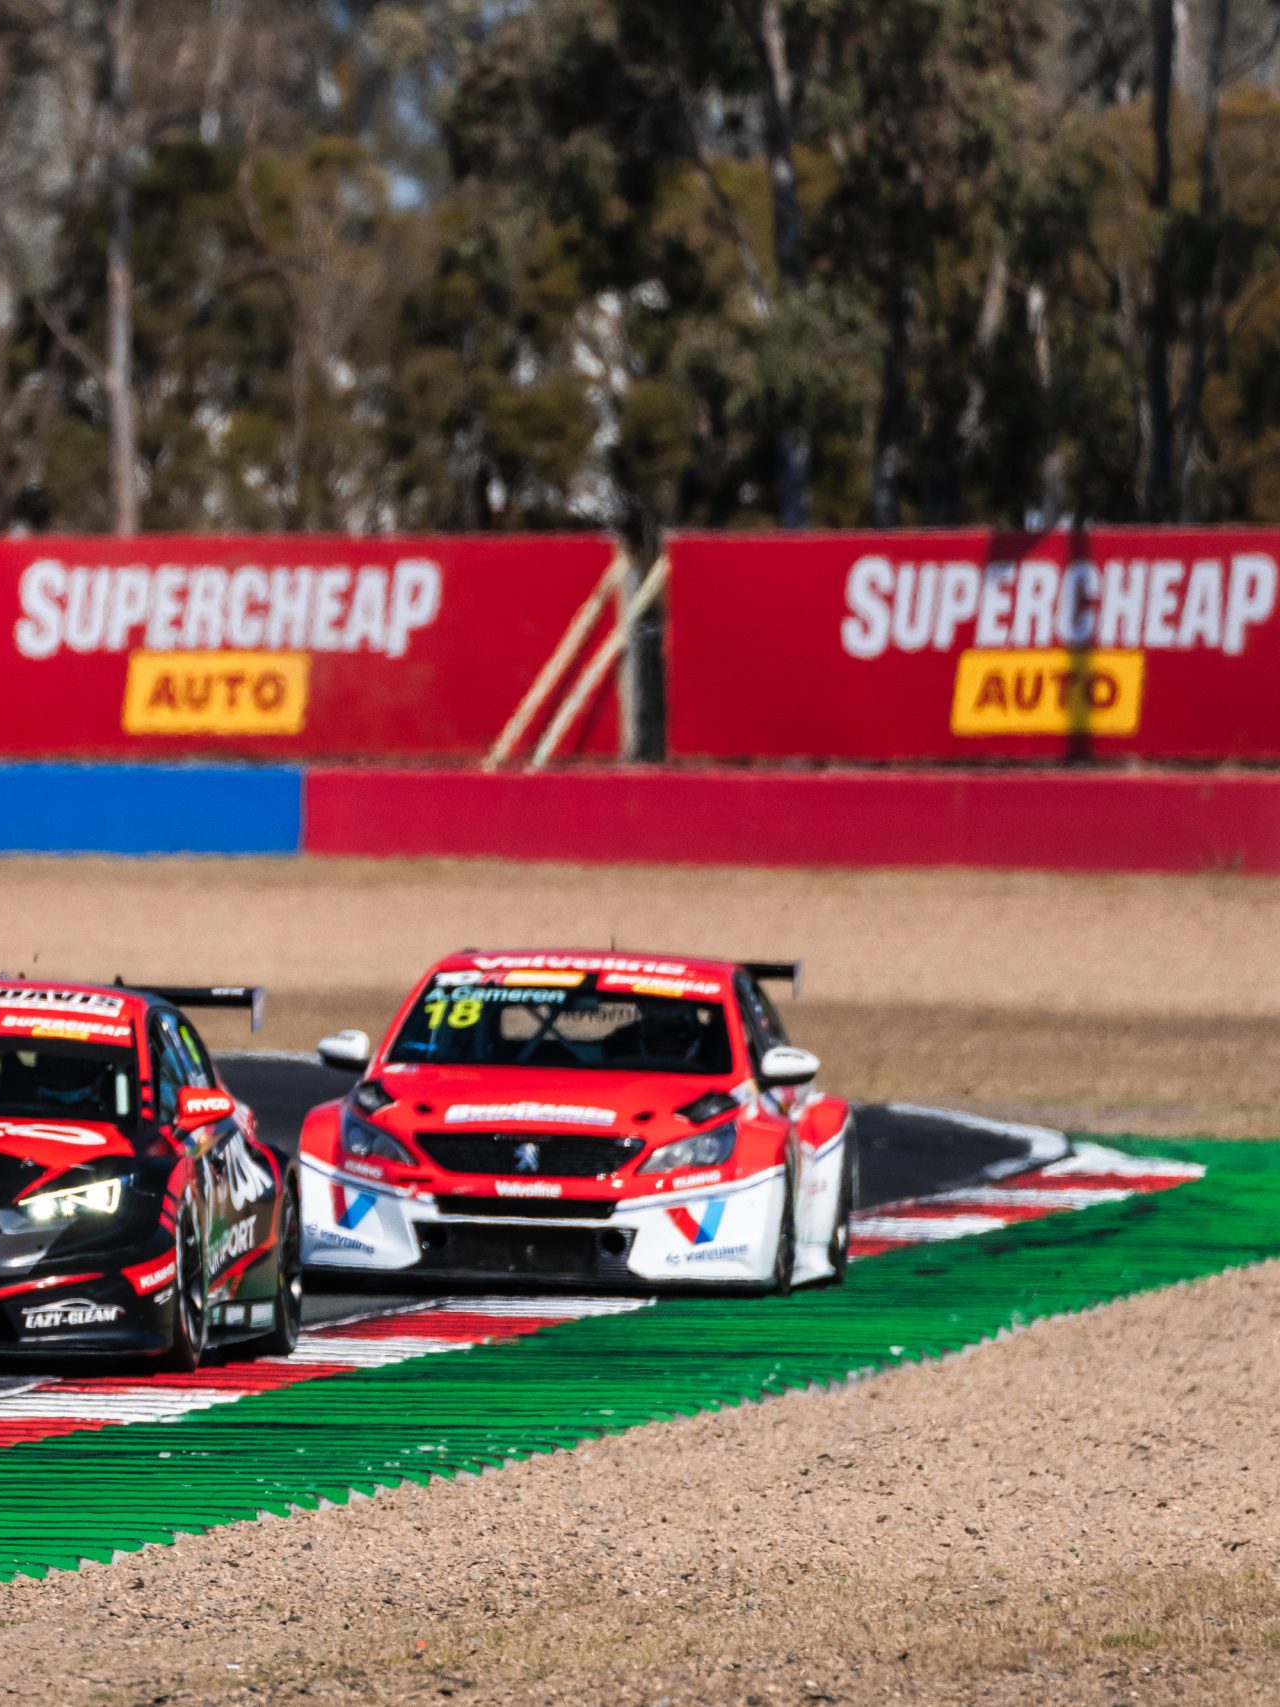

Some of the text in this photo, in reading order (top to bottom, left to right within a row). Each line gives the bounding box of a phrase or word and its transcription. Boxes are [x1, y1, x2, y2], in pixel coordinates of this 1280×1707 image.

[16, 557, 442, 658] SUPERCHEAP
[841, 554, 1278, 659] SUPERCHEAP
[149, 671, 286, 713] AUTO
[973, 670, 1119, 711] AUTO
[425, 1001, 483, 1028] 18
